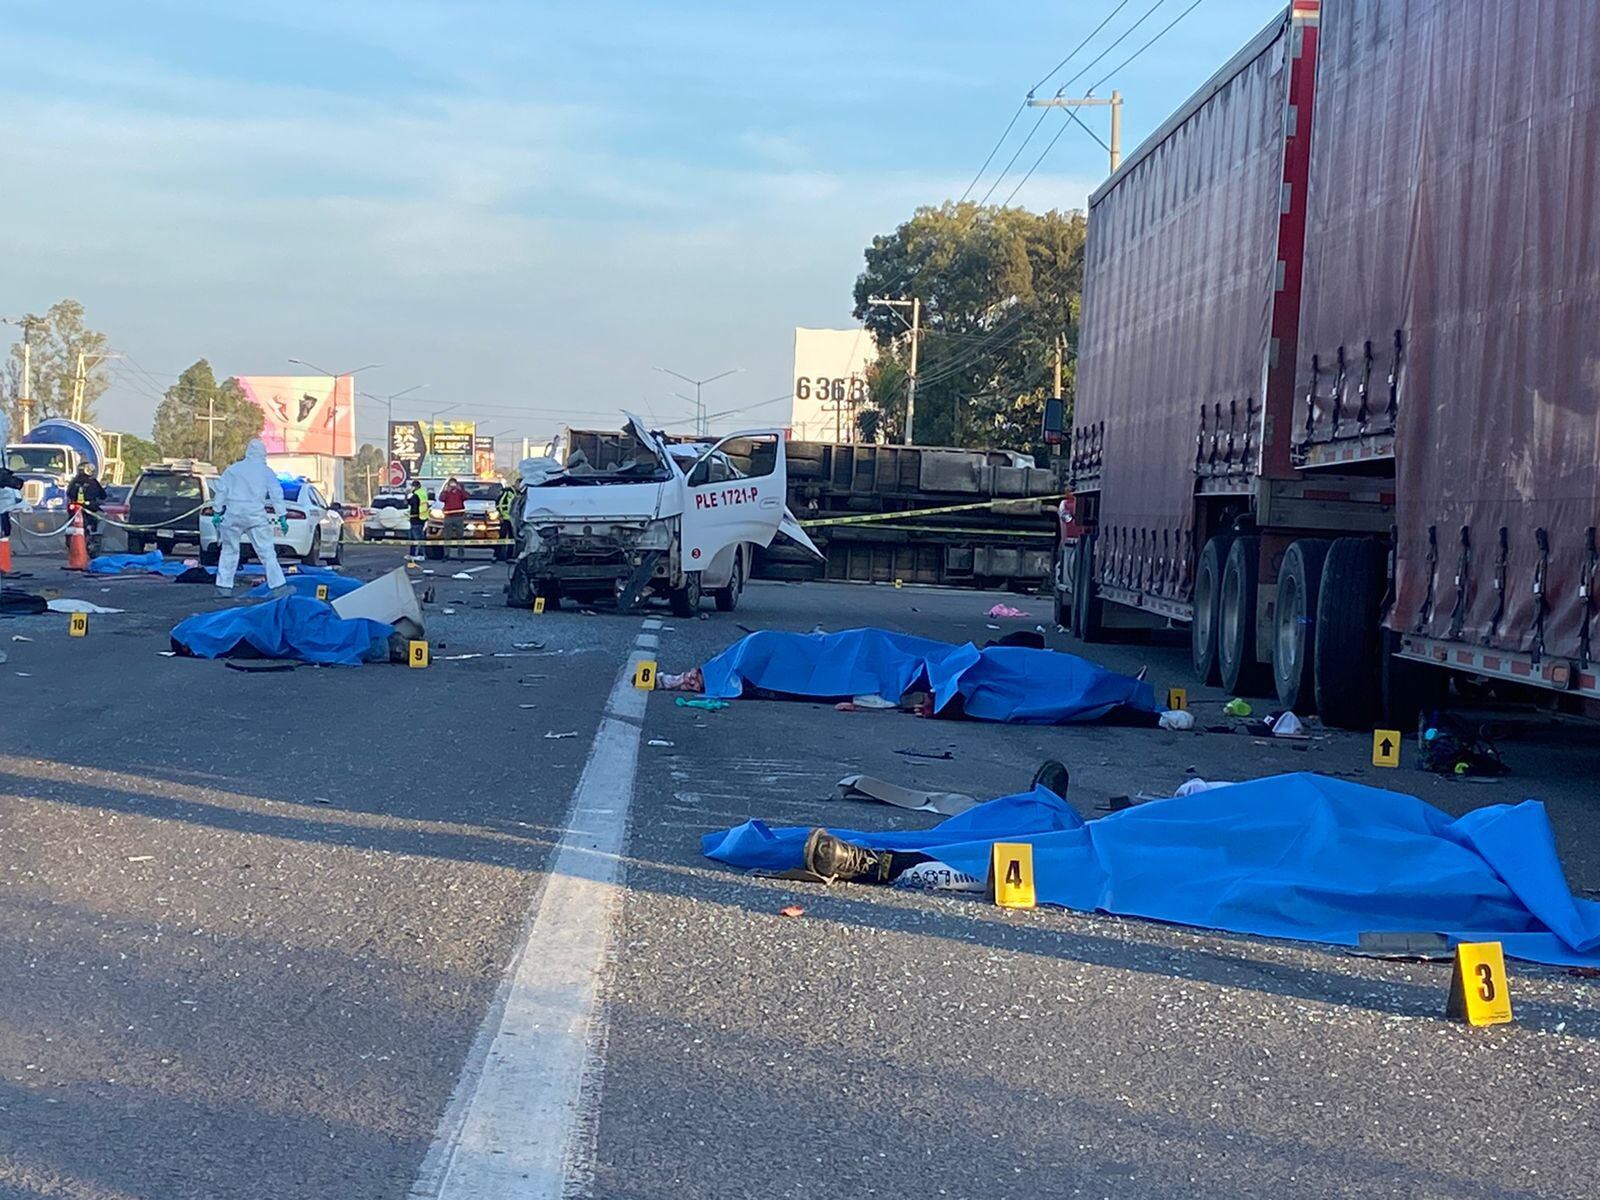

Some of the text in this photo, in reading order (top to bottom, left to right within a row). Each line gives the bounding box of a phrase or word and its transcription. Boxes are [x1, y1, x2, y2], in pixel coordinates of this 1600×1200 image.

[695, 487, 758, 510] PLE 1721-P
[73, 619, 85, 630] 10
[415, 647, 423, 661] 9
[641, 668, 651, 682] 8
[1006, 860, 1022, 889] 4
[1475, 964, 1495, 1002] 3
